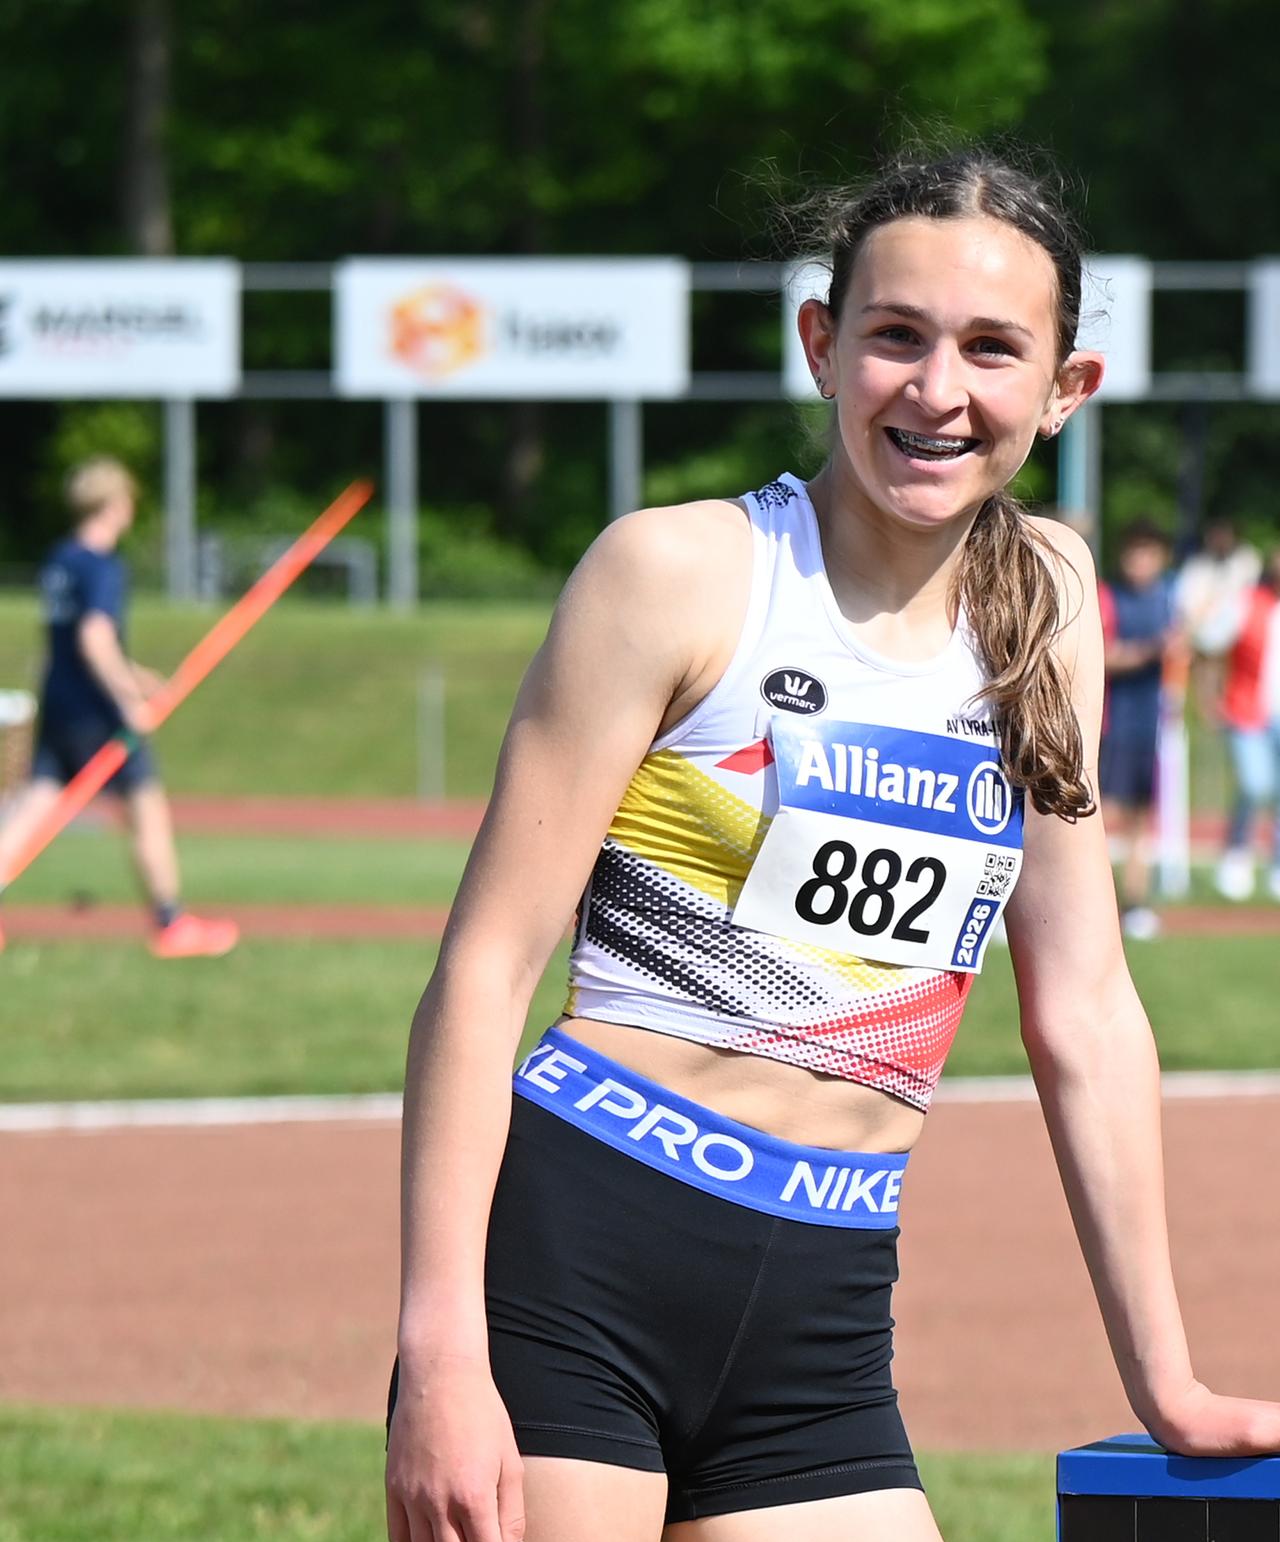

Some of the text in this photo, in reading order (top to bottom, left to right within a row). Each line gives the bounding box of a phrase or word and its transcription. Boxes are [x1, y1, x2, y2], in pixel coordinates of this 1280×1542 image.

[769, 691, 817, 711] vermarc
[946, 719, 959, 734] AV
[795, 740, 960, 814] Allianz
[795, 839, 947, 944] 882
[957, 904, 991, 965] 2026
[573, 1077, 754, 1182] PRO
[779, 1160, 905, 1213] NIKE
